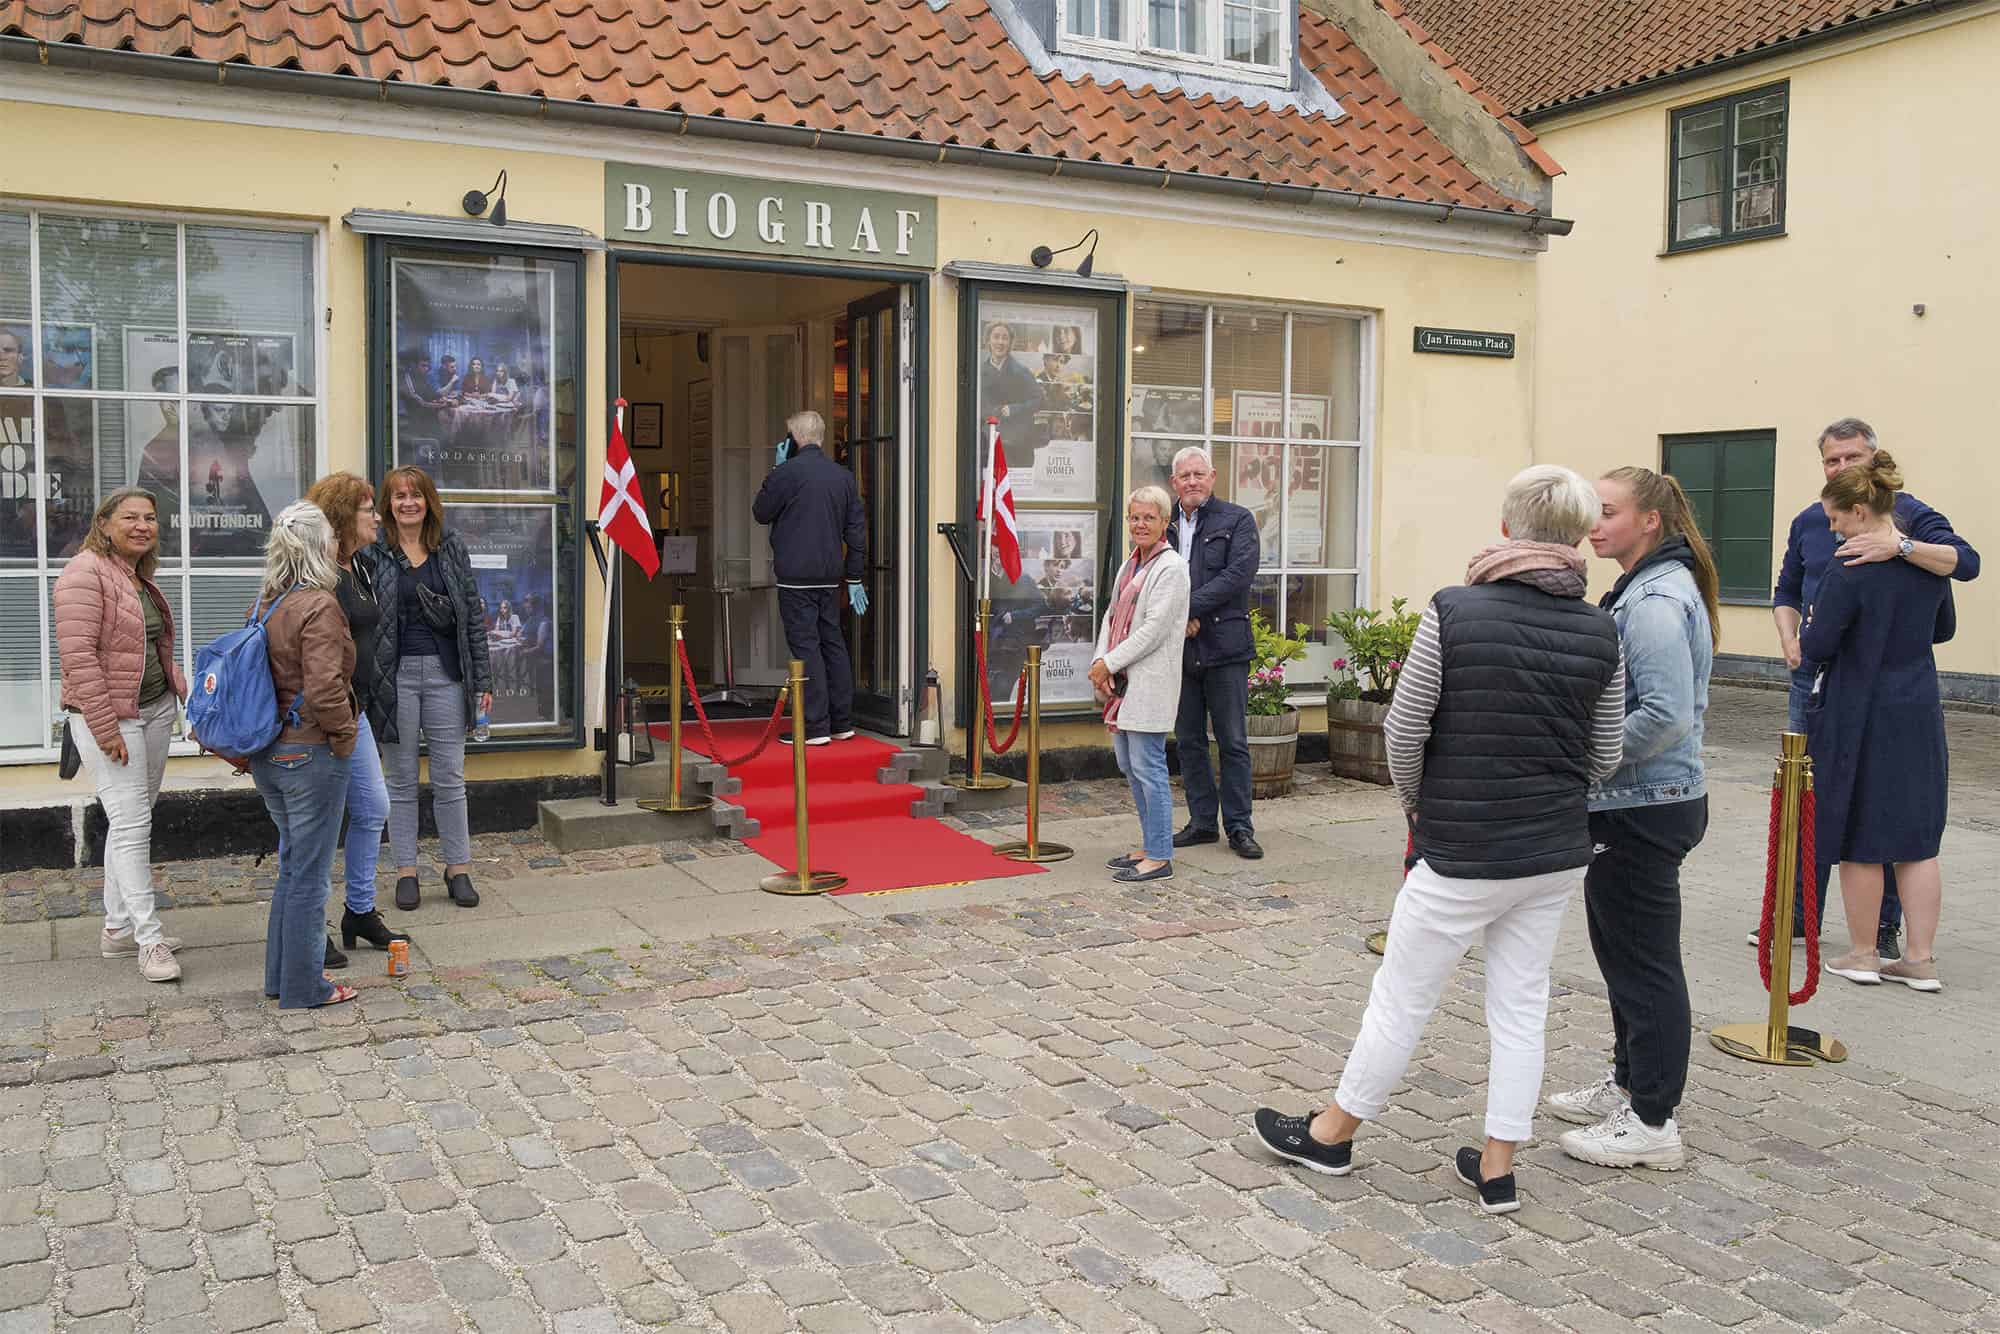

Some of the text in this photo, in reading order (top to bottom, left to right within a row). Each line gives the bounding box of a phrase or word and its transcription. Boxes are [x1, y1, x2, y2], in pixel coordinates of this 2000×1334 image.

[623, 182, 920, 255] BIOGRAF
[1426, 333, 1509, 349] Jan Timanns Plads
[1047, 455, 1073, 466] LITTLE
[1046, 465, 1075, 476] WOMEN
[1238, 456, 1321, 491] ROSE
[170, 512, 263, 529] KUDTTØNDEN
[1047, 658, 1073, 669] LITTLE
[1046, 668, 1075, 680] WOMEN
